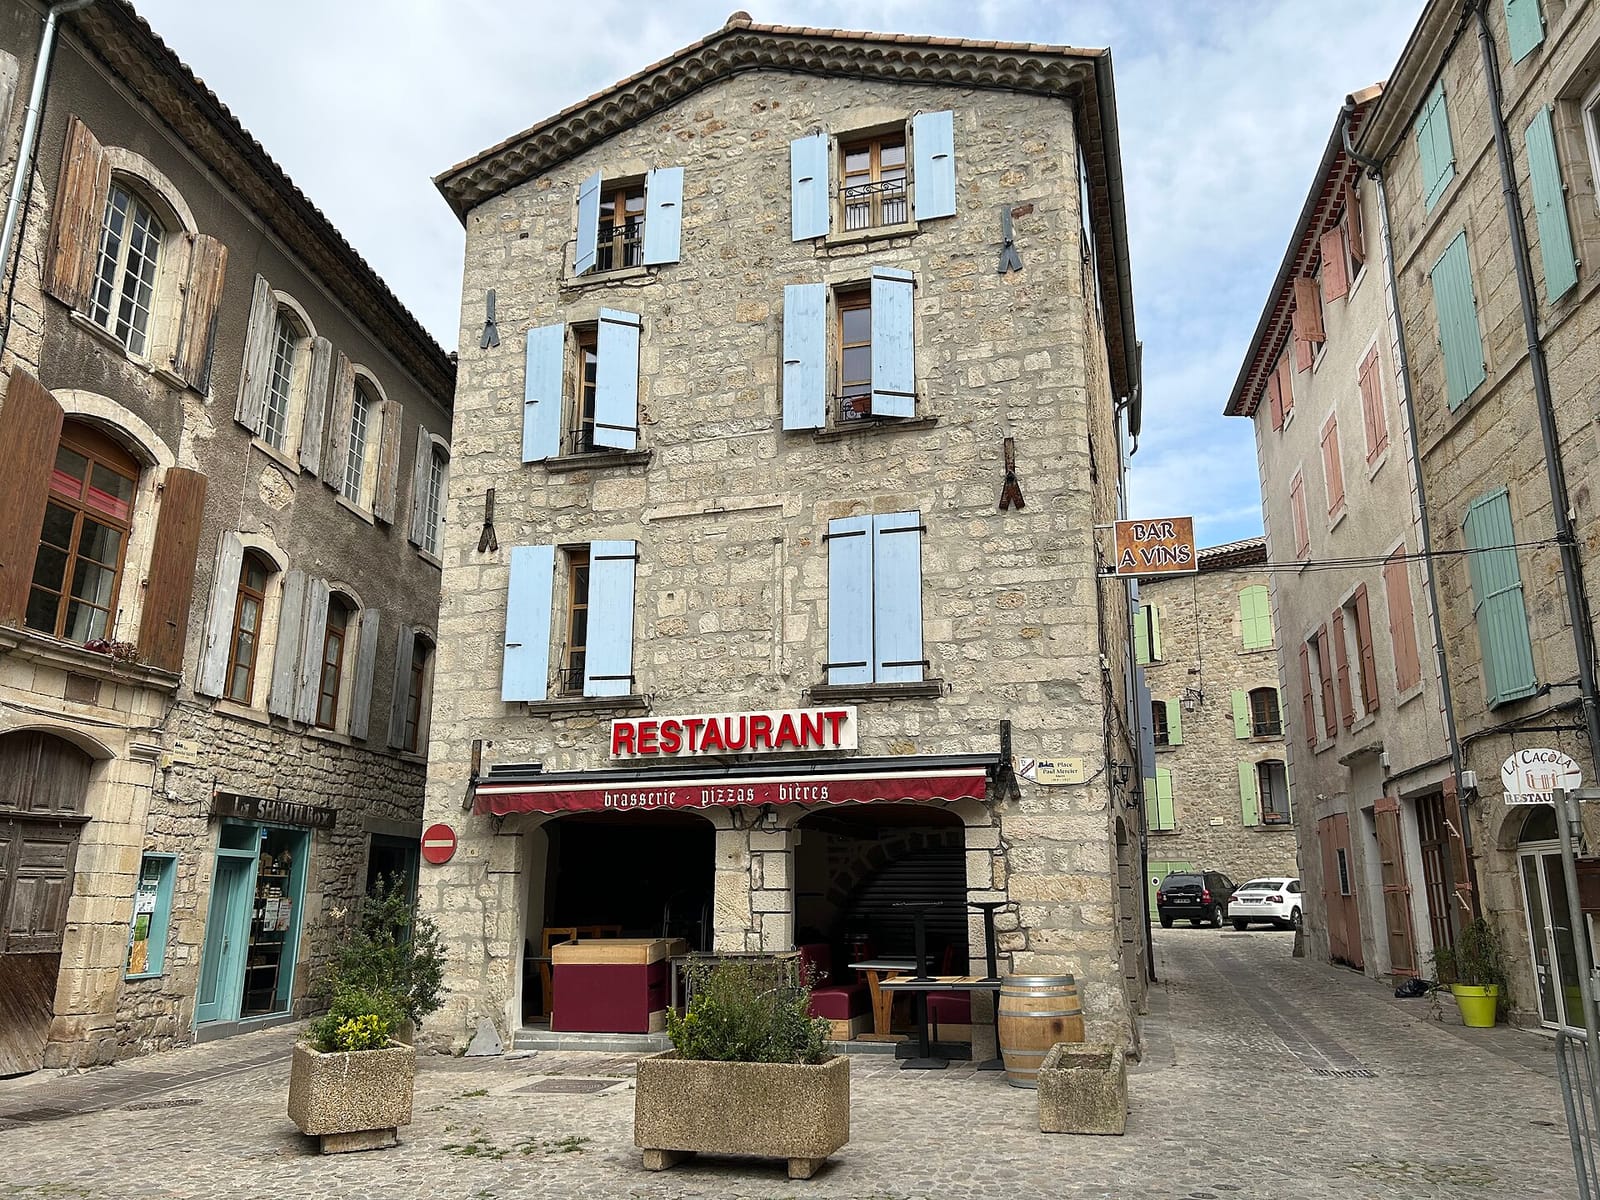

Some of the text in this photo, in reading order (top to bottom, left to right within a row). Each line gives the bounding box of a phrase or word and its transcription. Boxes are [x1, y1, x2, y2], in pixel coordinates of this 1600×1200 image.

[1131, 521, 1176, 541] BAR
[1119, 544, 1191, 567] A VINS
[612, 711, 848, 756] RESTAURANT
[604, 788, 676, 807] brasserie
[701, 787, 754, 806] pizzas
[779, 783, 829, 801] bières
[1505, 792, 1553, 803] RESTAU
